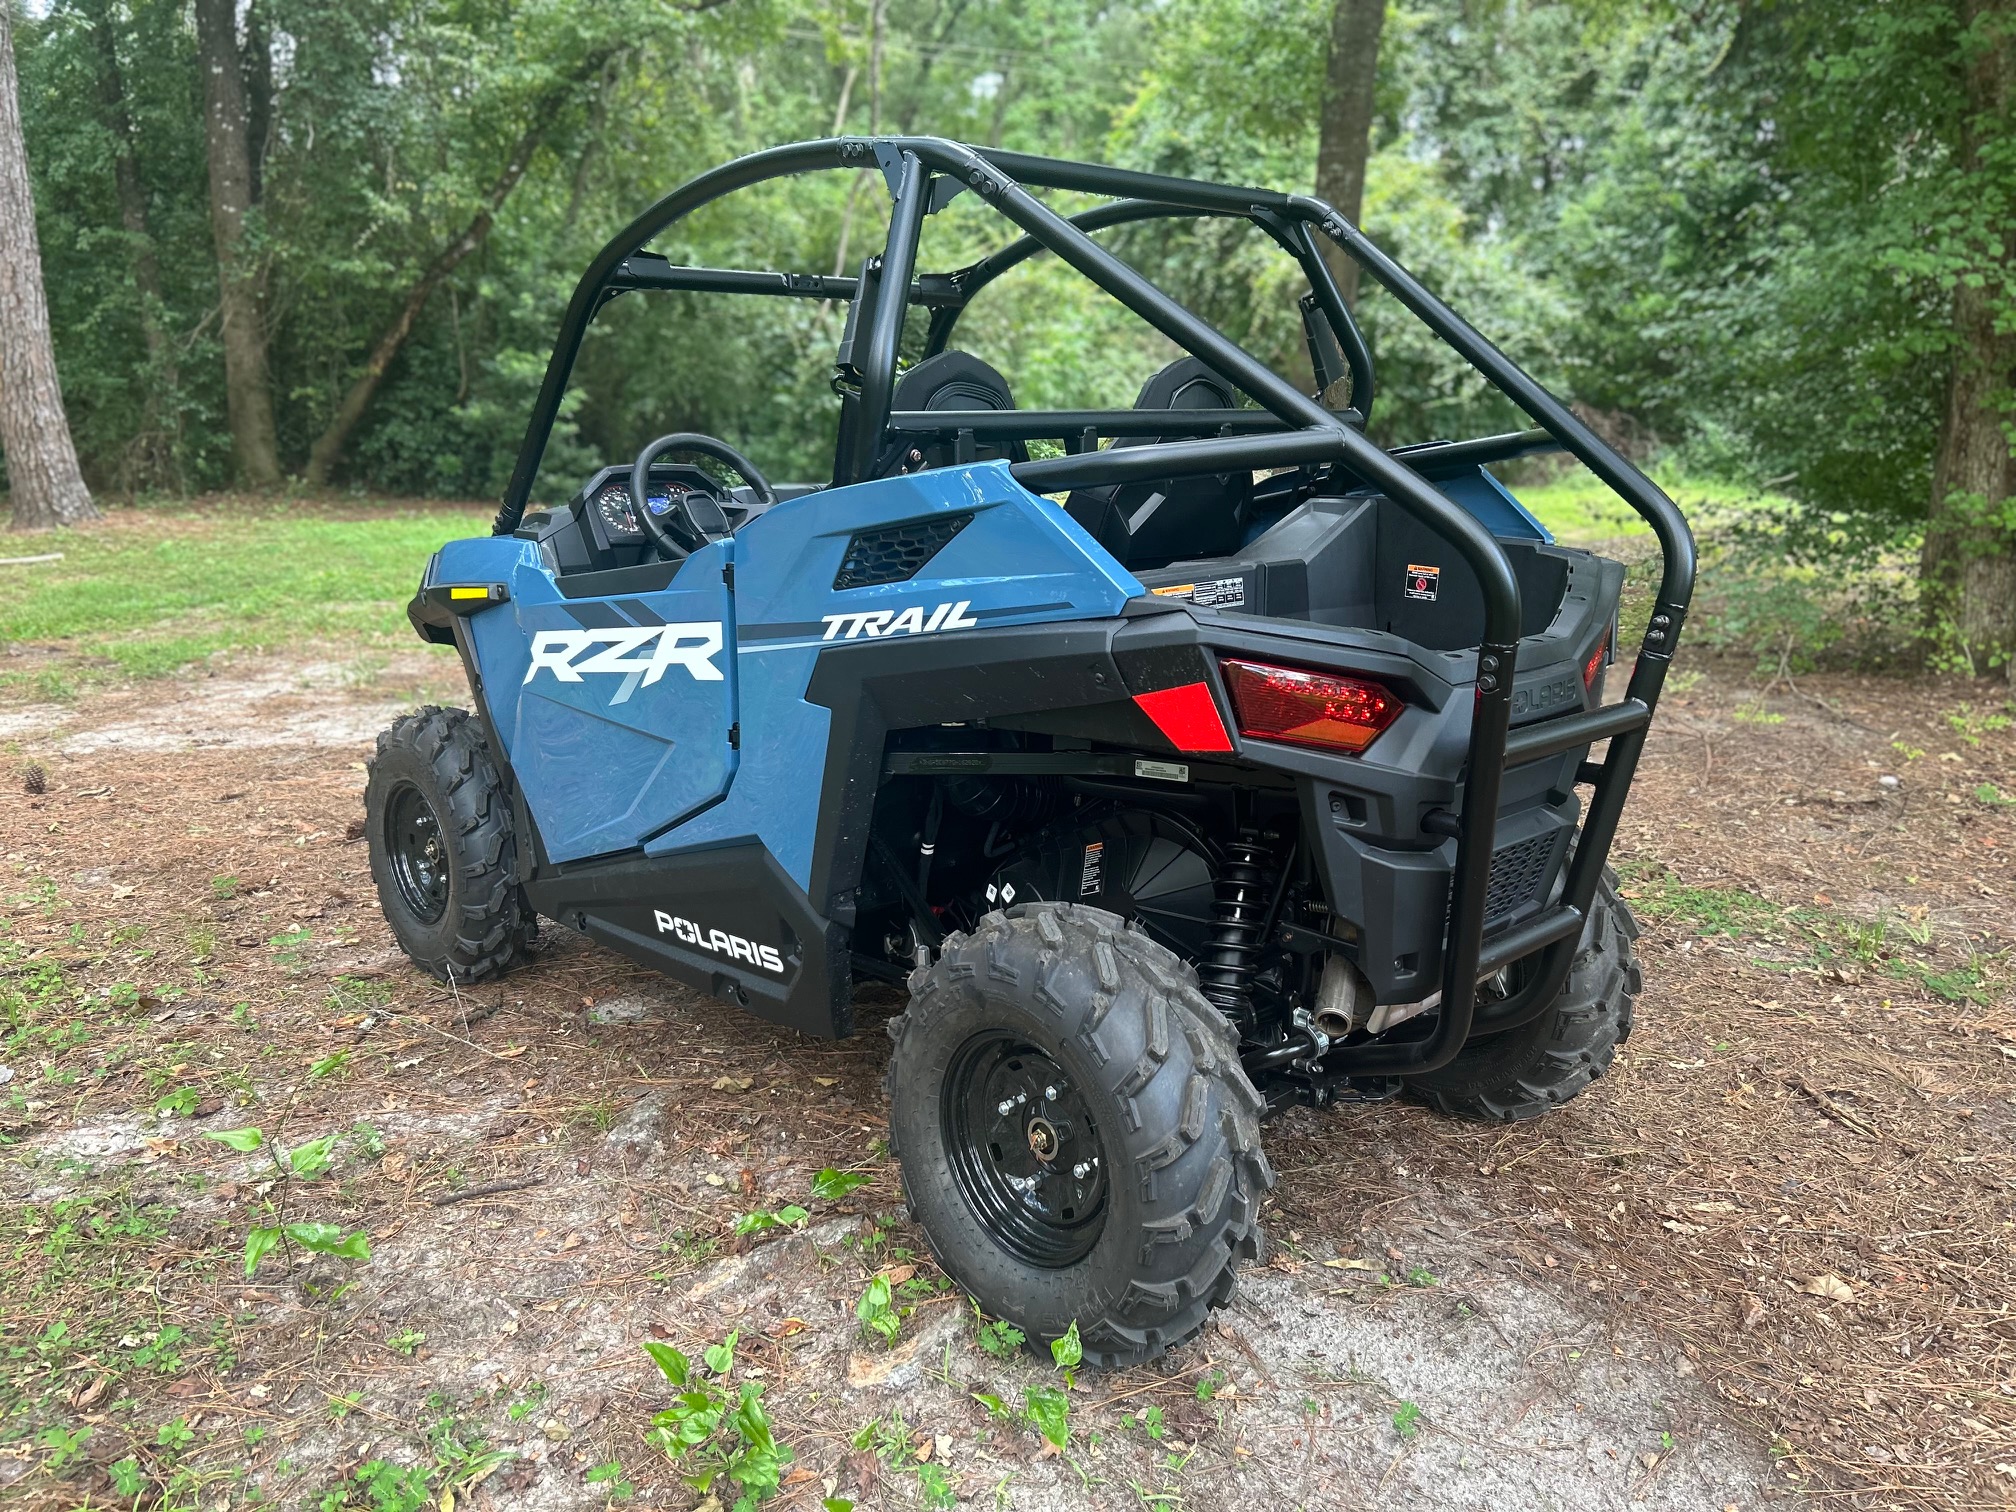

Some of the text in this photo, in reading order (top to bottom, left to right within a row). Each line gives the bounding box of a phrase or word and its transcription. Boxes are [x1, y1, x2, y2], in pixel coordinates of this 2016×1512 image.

[821, 600, 978, 640] TRAIL
[522, 621, 724, 690] RZR
[1512, 677, 1576, 715] OLARIS
[653, 909, 784, 973] POLARIS
